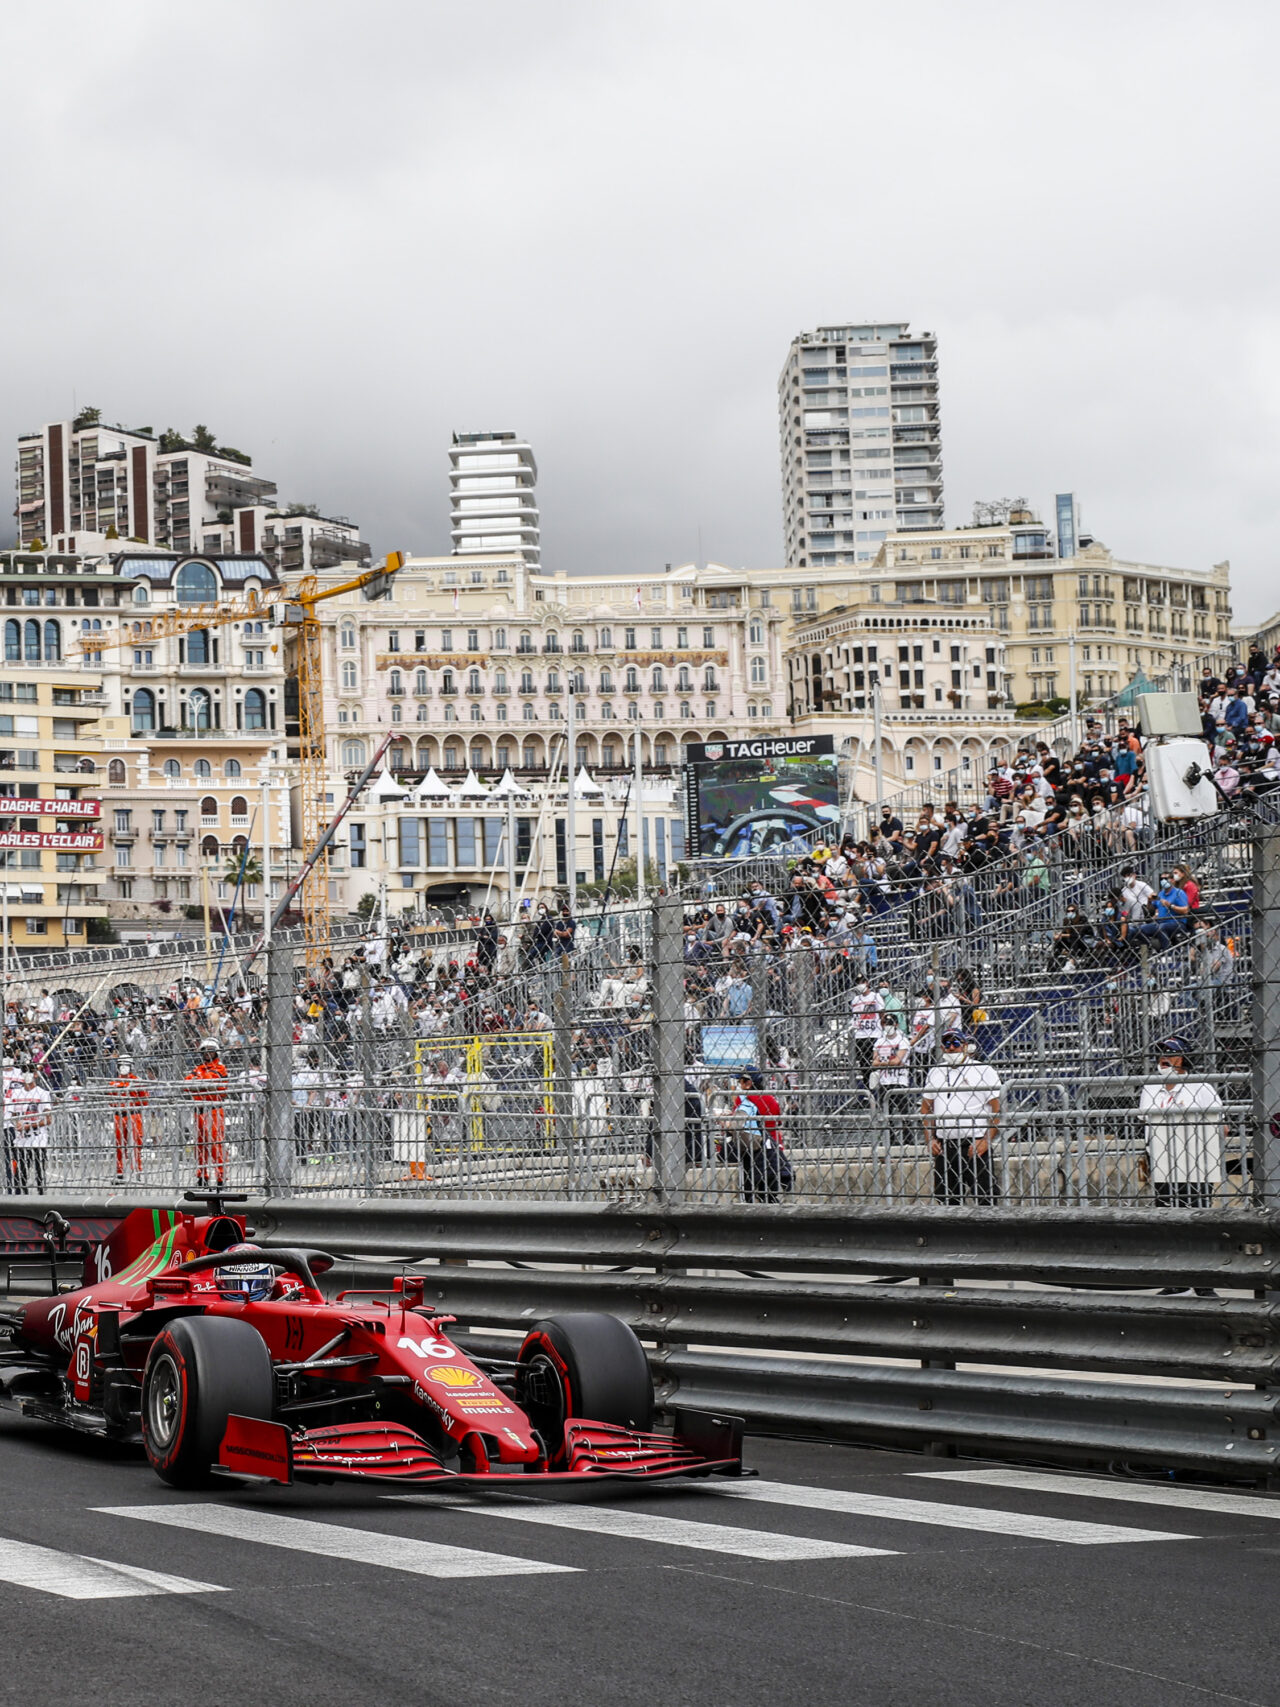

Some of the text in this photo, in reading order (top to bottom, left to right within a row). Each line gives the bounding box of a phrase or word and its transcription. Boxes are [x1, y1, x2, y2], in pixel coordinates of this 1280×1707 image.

[0, 799, 96, 815] DAGHE CHARLIE
[43, 835, 94, 848] L'ECLAIR
[94, 1244, 112, 1284] 16
[396, 1337, 457, 1359] 16
[413, 1379, 456, 1432] kaspersky
[461, 1407, 515, 1415] MAHLE
[317, 1453, 383, 1463] V-Power
